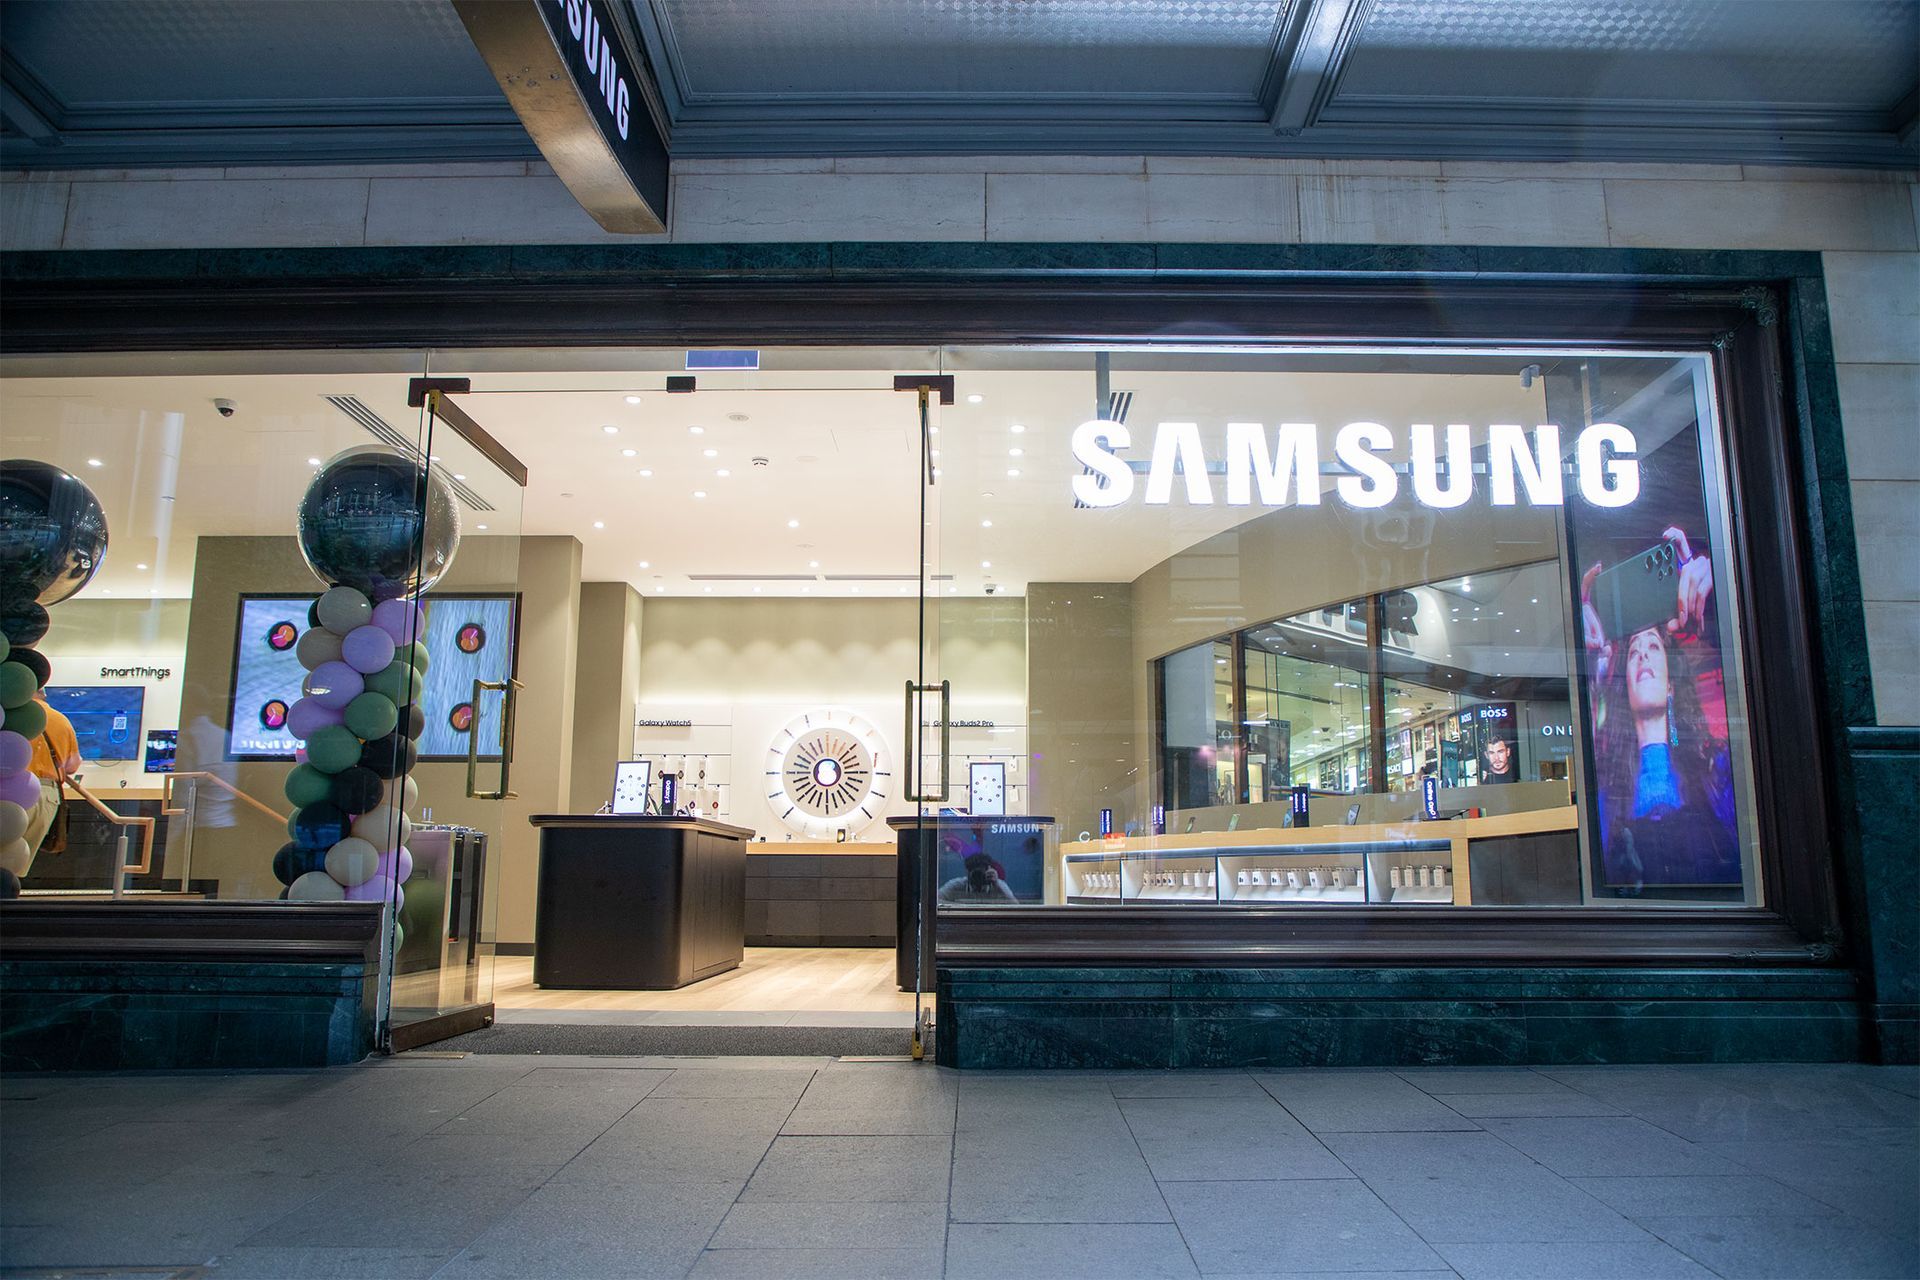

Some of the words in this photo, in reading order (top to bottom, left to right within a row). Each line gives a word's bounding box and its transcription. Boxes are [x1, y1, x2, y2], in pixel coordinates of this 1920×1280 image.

[557, 0, 630, 141] SUNG
[1071, 420, 1640, 508] SAMSUNG
[100, 667, 171, 680] SmartThings
[1480, 708, 1508, 718] BOSS
[639, 719, 664, 727] Galaxy
[665, 719, 692, 727] Watch5
[960, 720, 981, 728] Buds2
[982, 720, 994, 728] Pro
[991, 823, 1039, 834] SAMSUN
